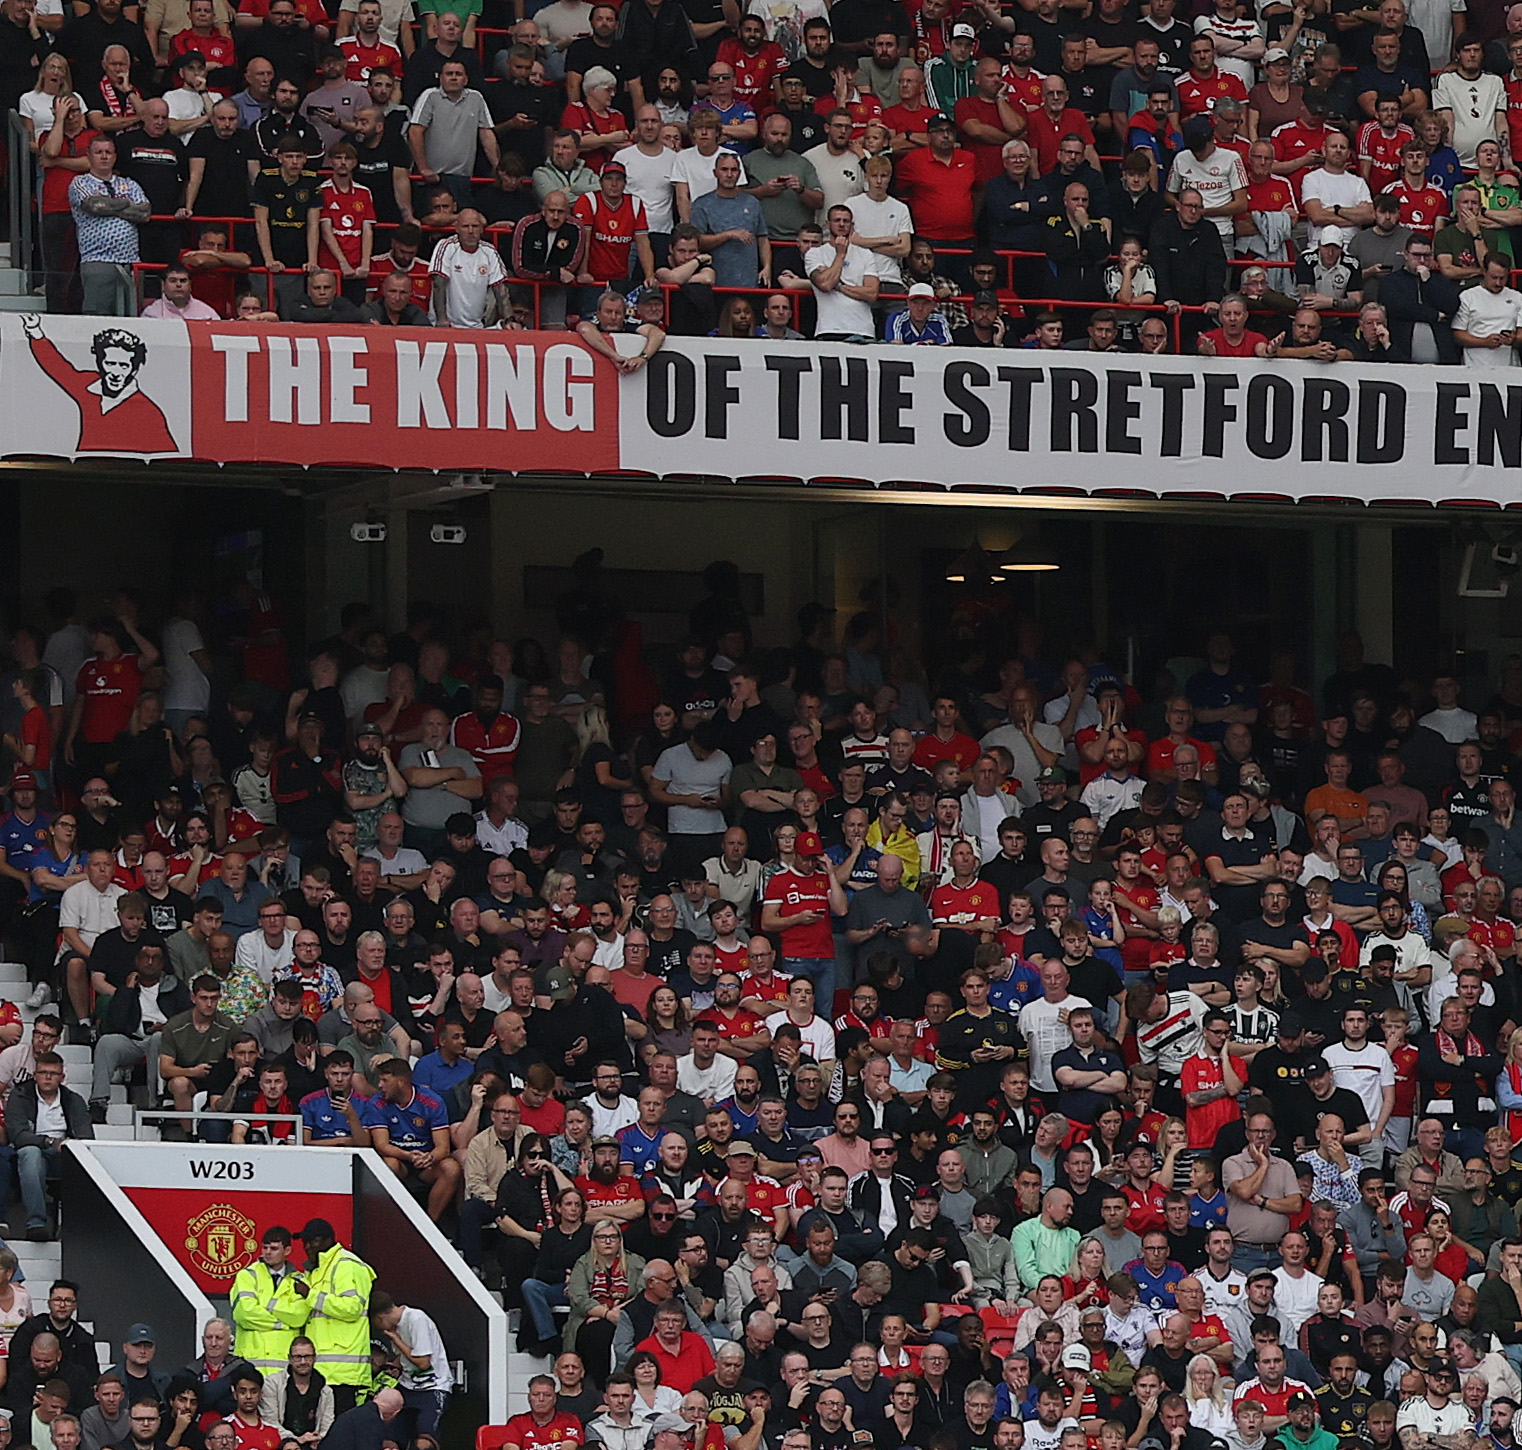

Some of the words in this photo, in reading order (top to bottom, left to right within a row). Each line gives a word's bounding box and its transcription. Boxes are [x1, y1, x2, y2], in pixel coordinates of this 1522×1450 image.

[1197, 180, 1223, 190] Tezos
[595, 232, 632, 243] SHARP
[211, 335, 371, 425] THE
[395, 340, 595, 432] KING
[642, 350, 742, 440] OF
[764, 355, 916, 445] THE
[944, 361, 1351, 463] STRETFORD
[1450, 803, 1489, 817] betway
[190, 1160, 255, 1180] W203
[193, 1210, 250, 1236] MANCHESTER
[201, 1259, 242, 1275] UNITED
